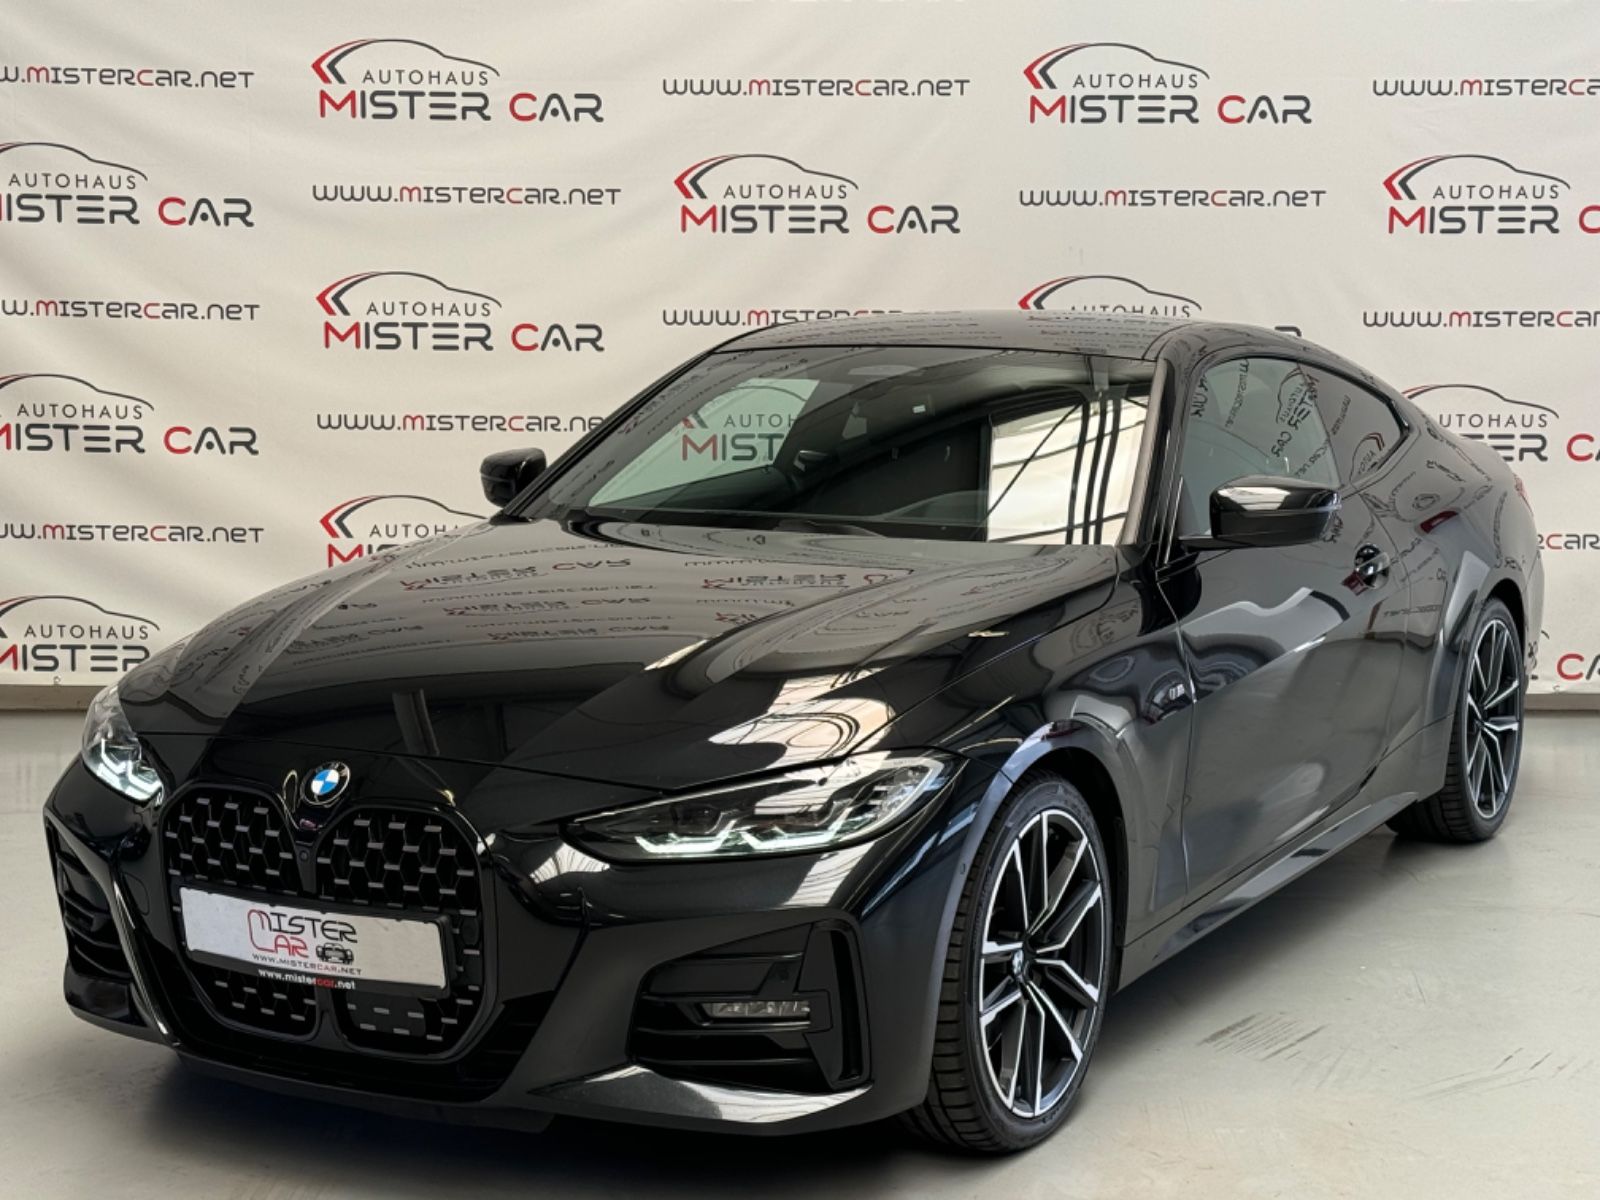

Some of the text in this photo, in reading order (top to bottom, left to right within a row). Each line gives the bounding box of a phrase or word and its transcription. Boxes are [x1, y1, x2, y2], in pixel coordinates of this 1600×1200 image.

[362, 69, 489, 86] AUTOHAUS
[1073, 74, 1199, 89] AUTOHAUS
[319, 89, 604, 122] MISTER CAR
[1030, 95, 1312, 124] MISTER CAR
[8, 173, 137, 190] AUTOHAUS
[723, 184, 847, 199] AUTOHAUS
[1433, 184, 1559, 200] AUTOHAUS
[0, 193, 254, 227] ISTER CAR
[681, 205, 960, 234] MISTER CAR
[1389, 205, 1560, 234] MISTER
[366, 301, 491, 317] AUTOHAUS
[324, 321, 605, 352] MISTER CAR
[17, 403, 143, 420] AUTOHAUS
[164, 426, 259, 456] CAR
[682, 432, 784, 461] MIST
[369, 523, 459, 539] AUTOH
[24, 624, 149, 640] AUTOHAUS
[258, 969, 357, 990] www.mistercar.net
